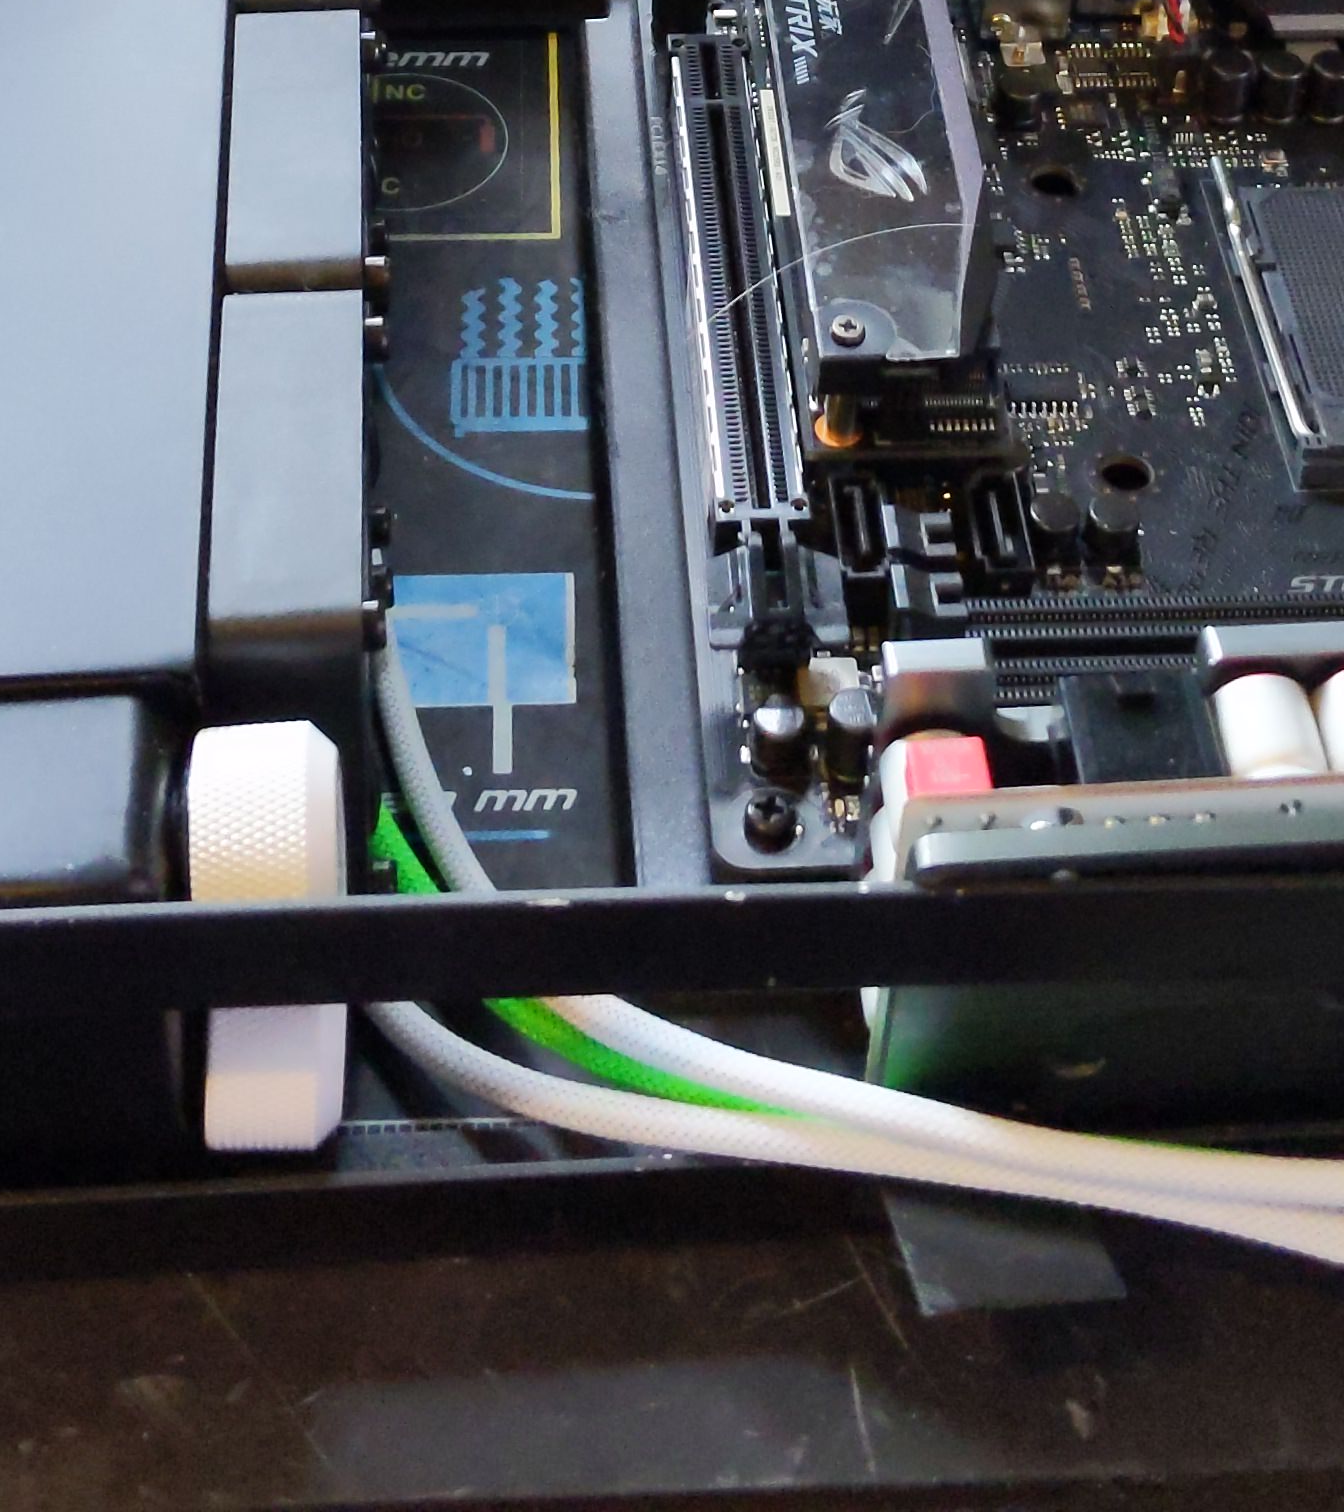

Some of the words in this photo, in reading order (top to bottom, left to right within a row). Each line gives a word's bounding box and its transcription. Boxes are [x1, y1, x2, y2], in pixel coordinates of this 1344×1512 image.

[385, 84, 426, 101] NC
[381, 176, 401, 194] C
[475, 787, 578, 811] mm
